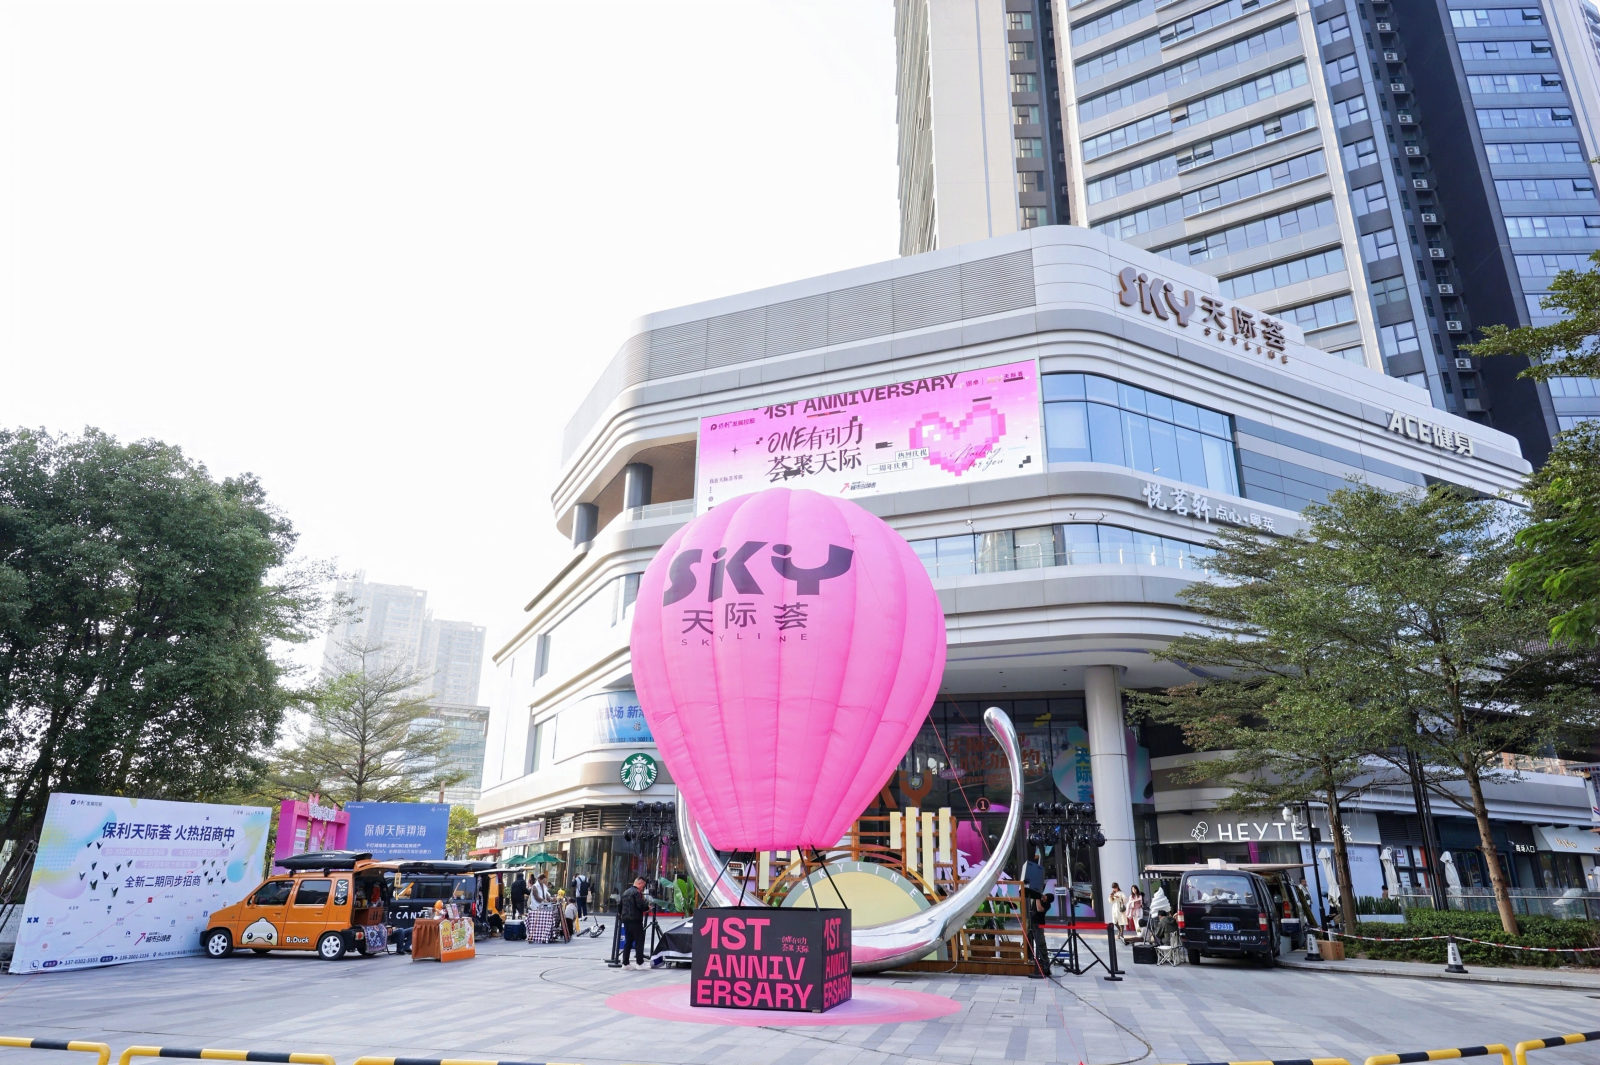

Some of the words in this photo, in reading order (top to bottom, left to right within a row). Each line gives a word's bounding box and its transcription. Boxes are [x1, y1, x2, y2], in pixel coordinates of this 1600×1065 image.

[1201, 295, 1286, 352] 天际荟
[764, 401, 799, 419] 1ST
[803, 373, 959, 414] ANNIVERSARY
[767, 418, 864, 454] ONE有引力
[1387, 409, 1474, 458] ACE健身
[765, 447, 862, 483] 荟聚天际
[681, 602, 809, 636] 天际荟
[681, 632, 808, 647] SKYLINE
[102, 822, 172, 840] 保利天际荟
[174, 825, 235, 842] 火热招商中
[1217, 822, 1312, 841] HEYTE
[124, 875, 201, 889] 全新二期同步招商
[801, 862, 918, 898] SKYLINE
[285, 936, 309, 944] B.Duck
[700, 917, 771, 951] 1ST
[824, 917, 842, 951] 1ST
[704, 953, 806, 981] ANNIV
[826, 950, 849, 980] ANNIV
[696, 979, 814, 1009] ERSARY
[823, 974, 852, 1009] ERSARY
